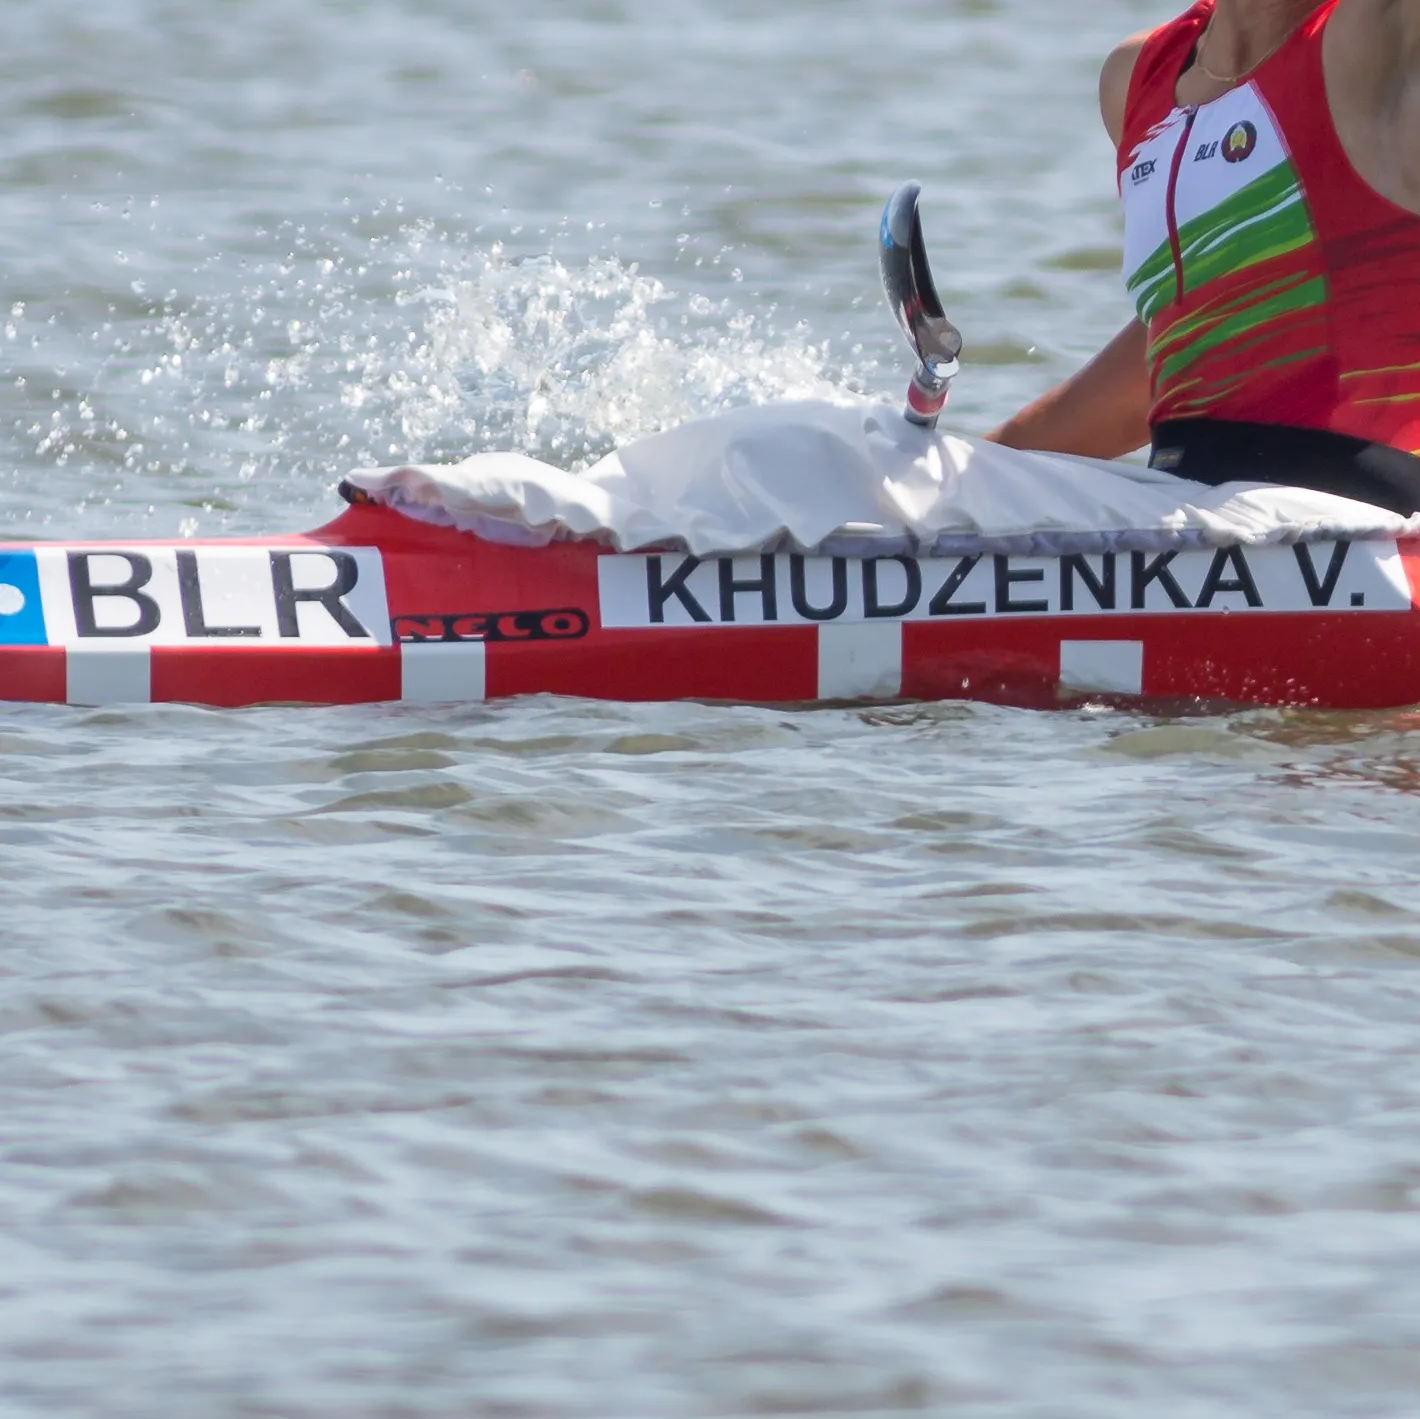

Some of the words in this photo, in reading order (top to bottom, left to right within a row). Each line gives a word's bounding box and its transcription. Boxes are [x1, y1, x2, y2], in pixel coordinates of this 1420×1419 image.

[1194, 140, 1218, 162] BLR
[67, 550, 370, 638] BLR
[646, 543, 1264, 623] KHUDZENKA
[1292, 540, 1365, 607] V.
[395, 611, 582, 637] NELO
